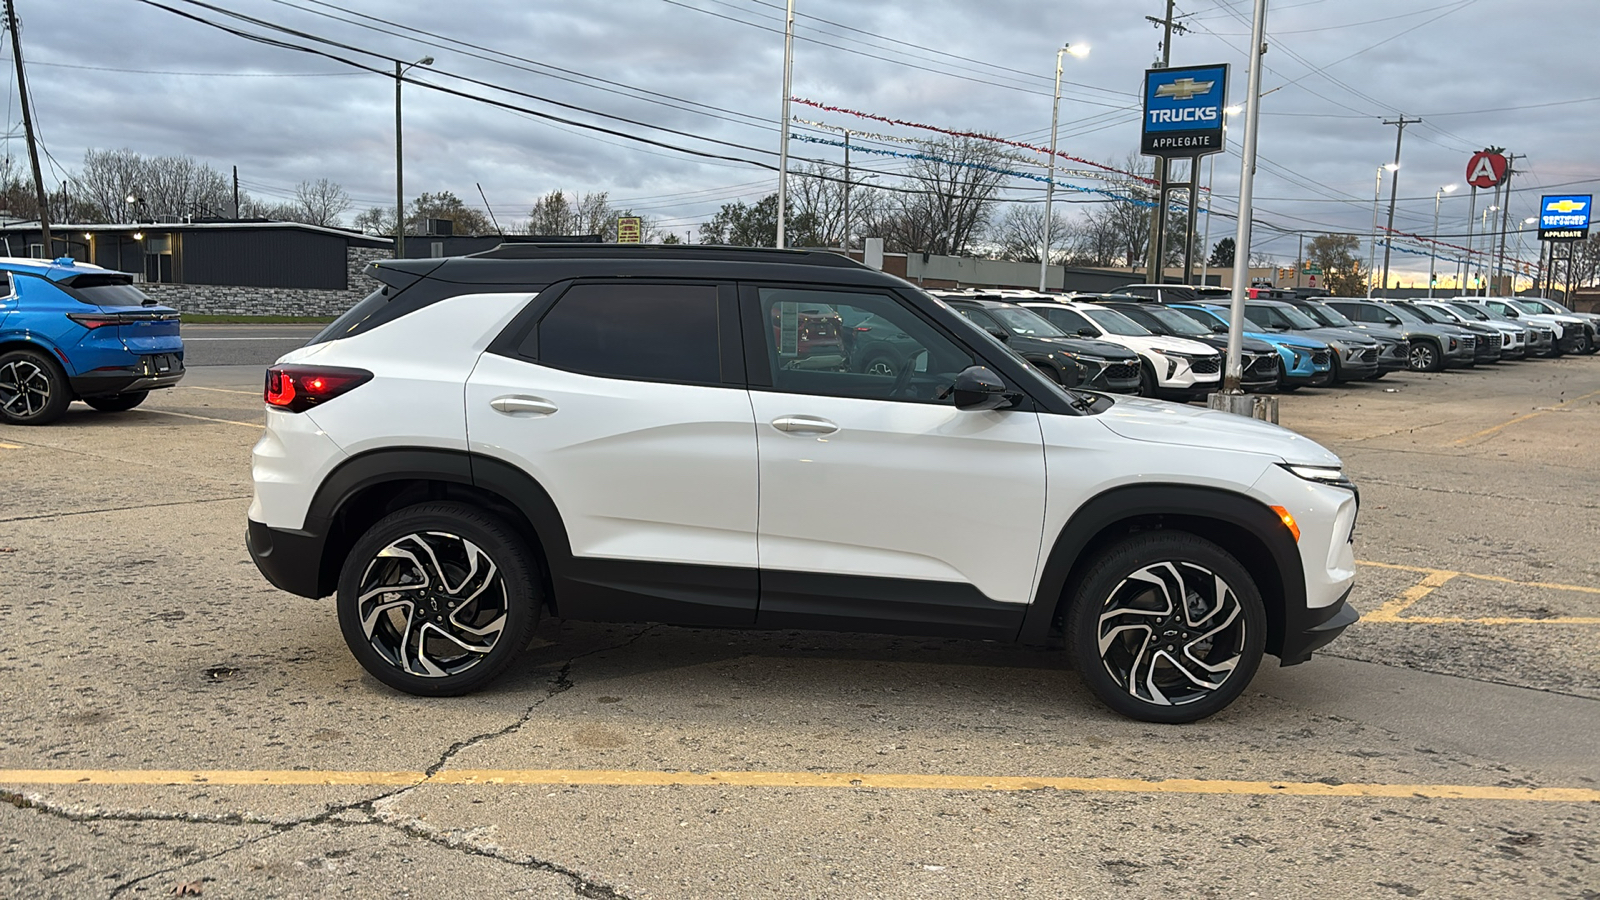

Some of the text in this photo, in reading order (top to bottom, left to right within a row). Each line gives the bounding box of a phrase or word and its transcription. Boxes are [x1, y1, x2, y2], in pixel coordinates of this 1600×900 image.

[1149, 107, 1217, 123] TRUCKS
[1153, 136, 1210, 148] APPLEGATE
[1469, 157, 1497, 182] A
